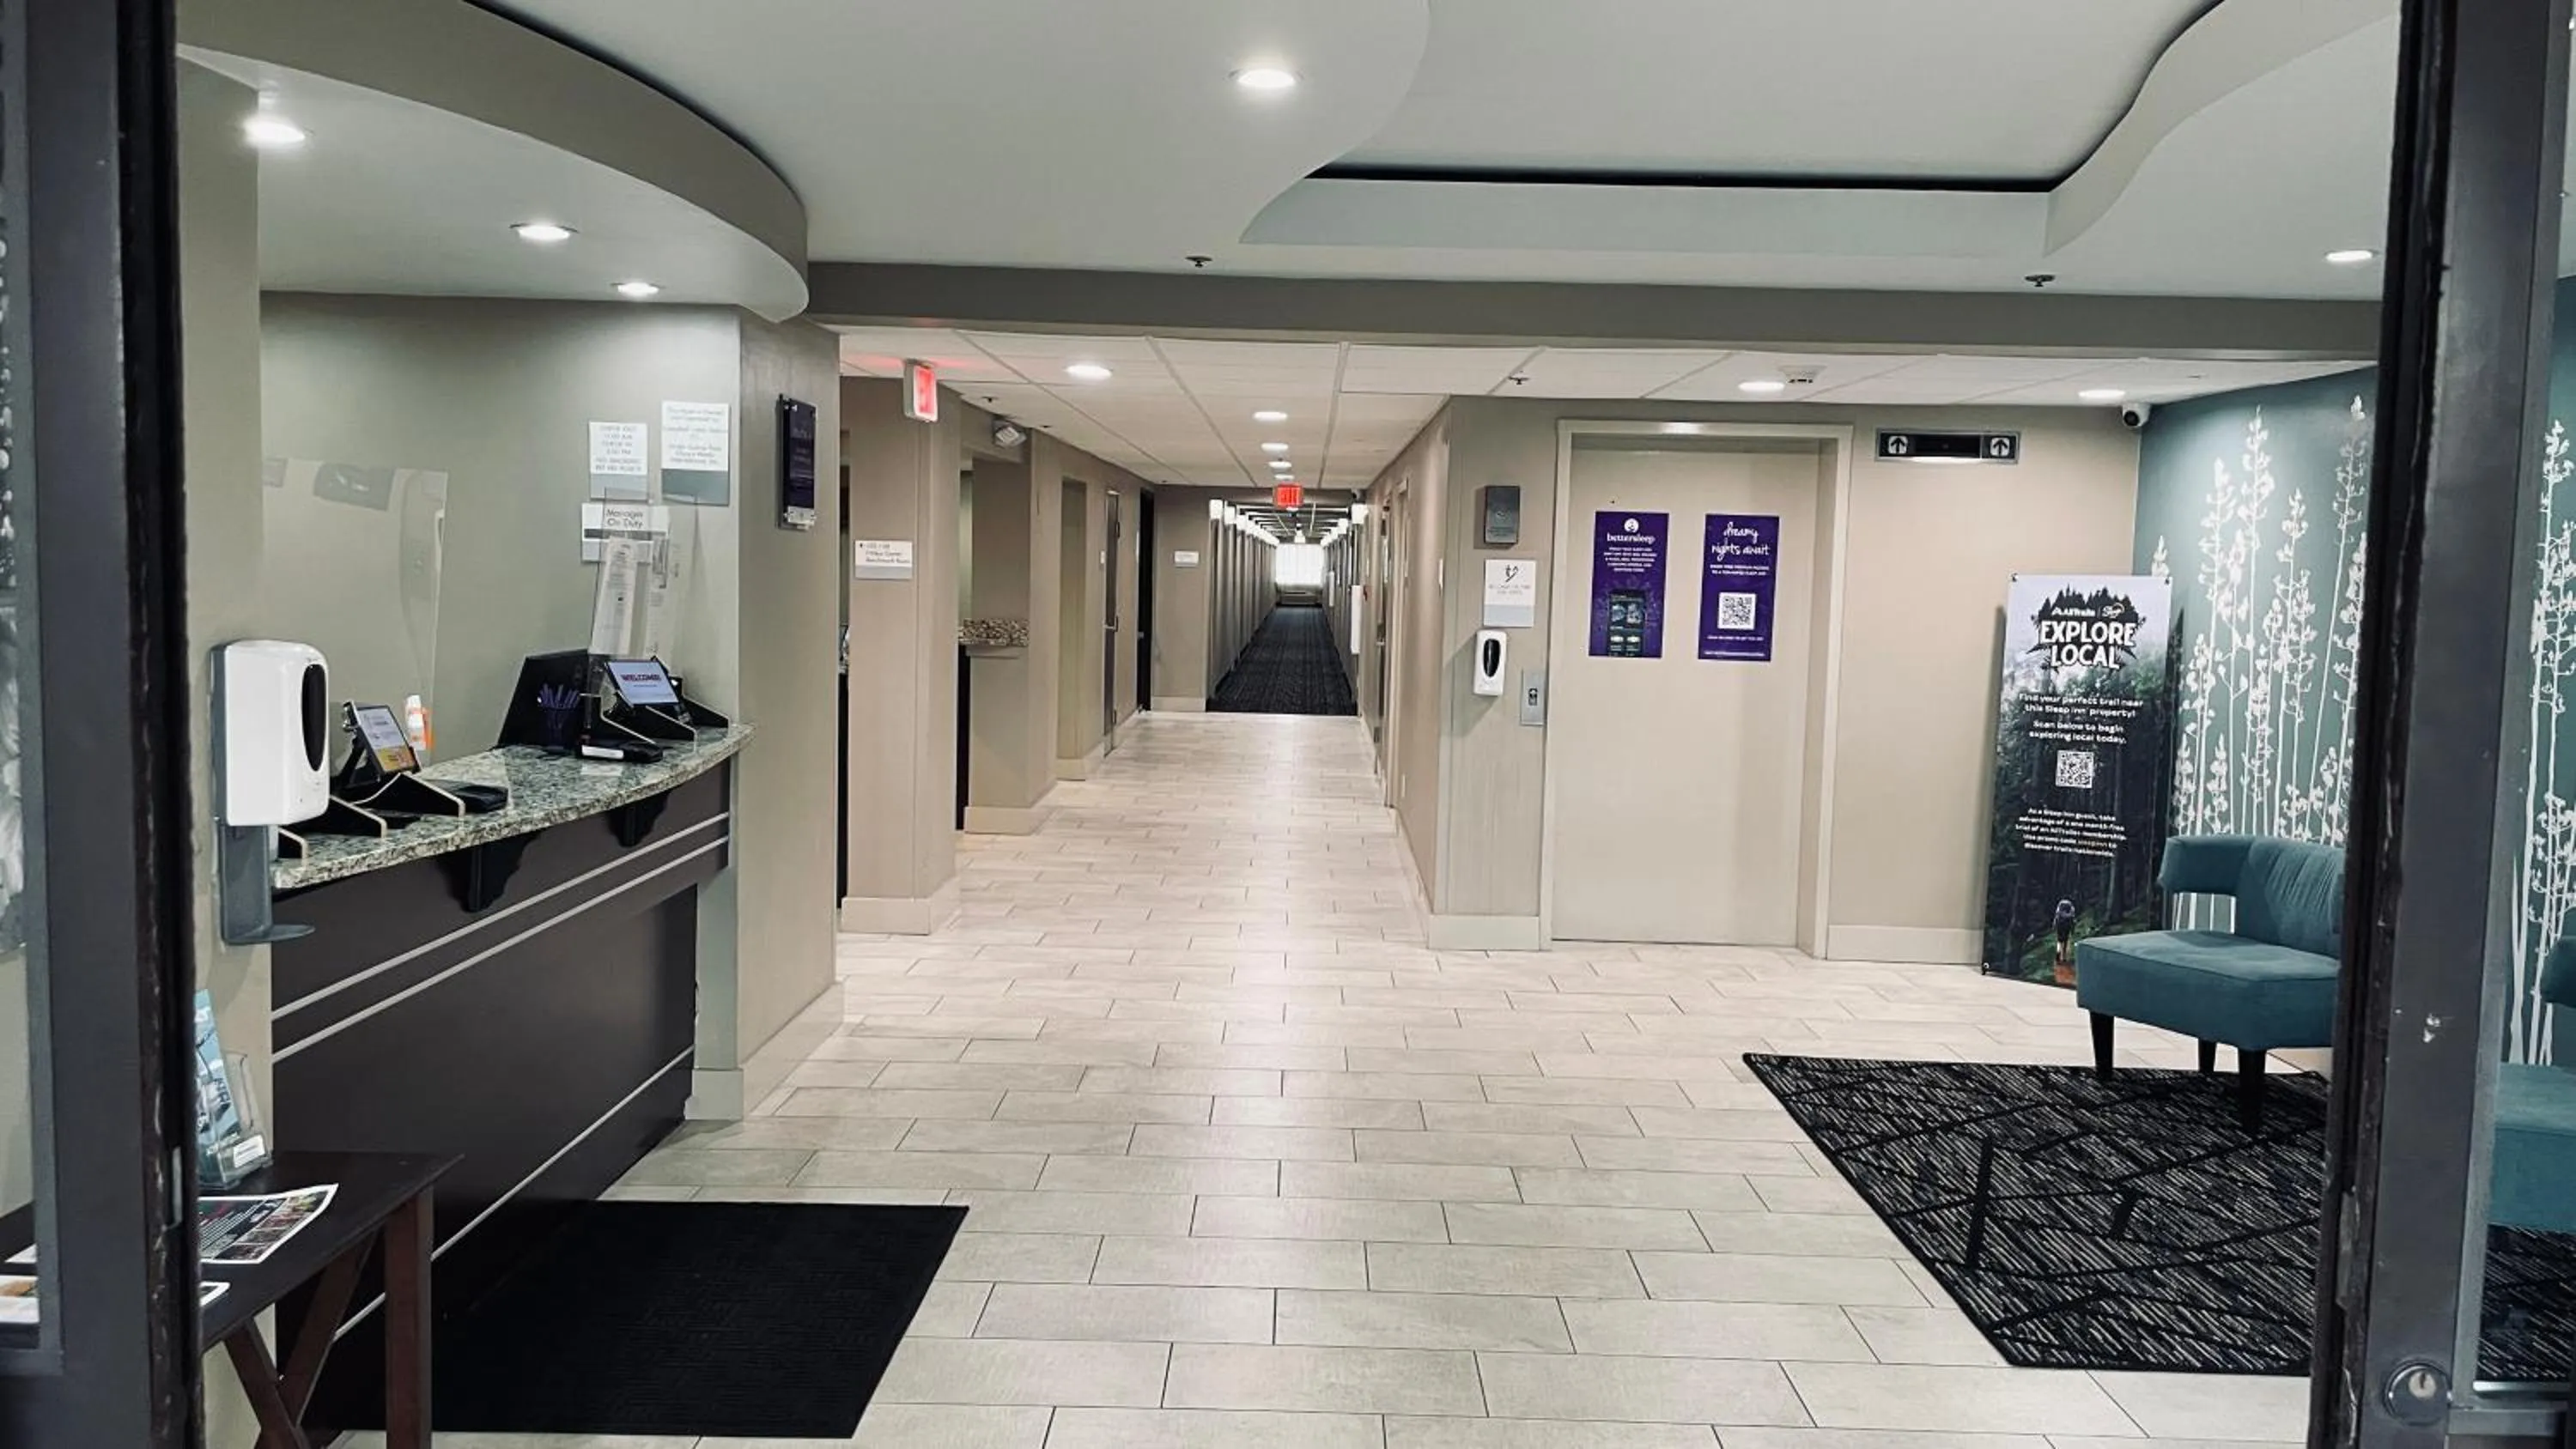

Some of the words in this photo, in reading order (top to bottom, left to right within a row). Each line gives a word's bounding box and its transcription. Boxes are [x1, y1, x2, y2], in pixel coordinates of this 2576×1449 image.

[2039, 620, 2137, 647] EXPLORE
[2050, 644, 2120, 670] LOCAL
[2019, 693, 2038, 701] Find
[2039, 695, 2061, 704] your
[2062, 696, 2098, 706] perfect
[2085, 723, 2097, 731] to
